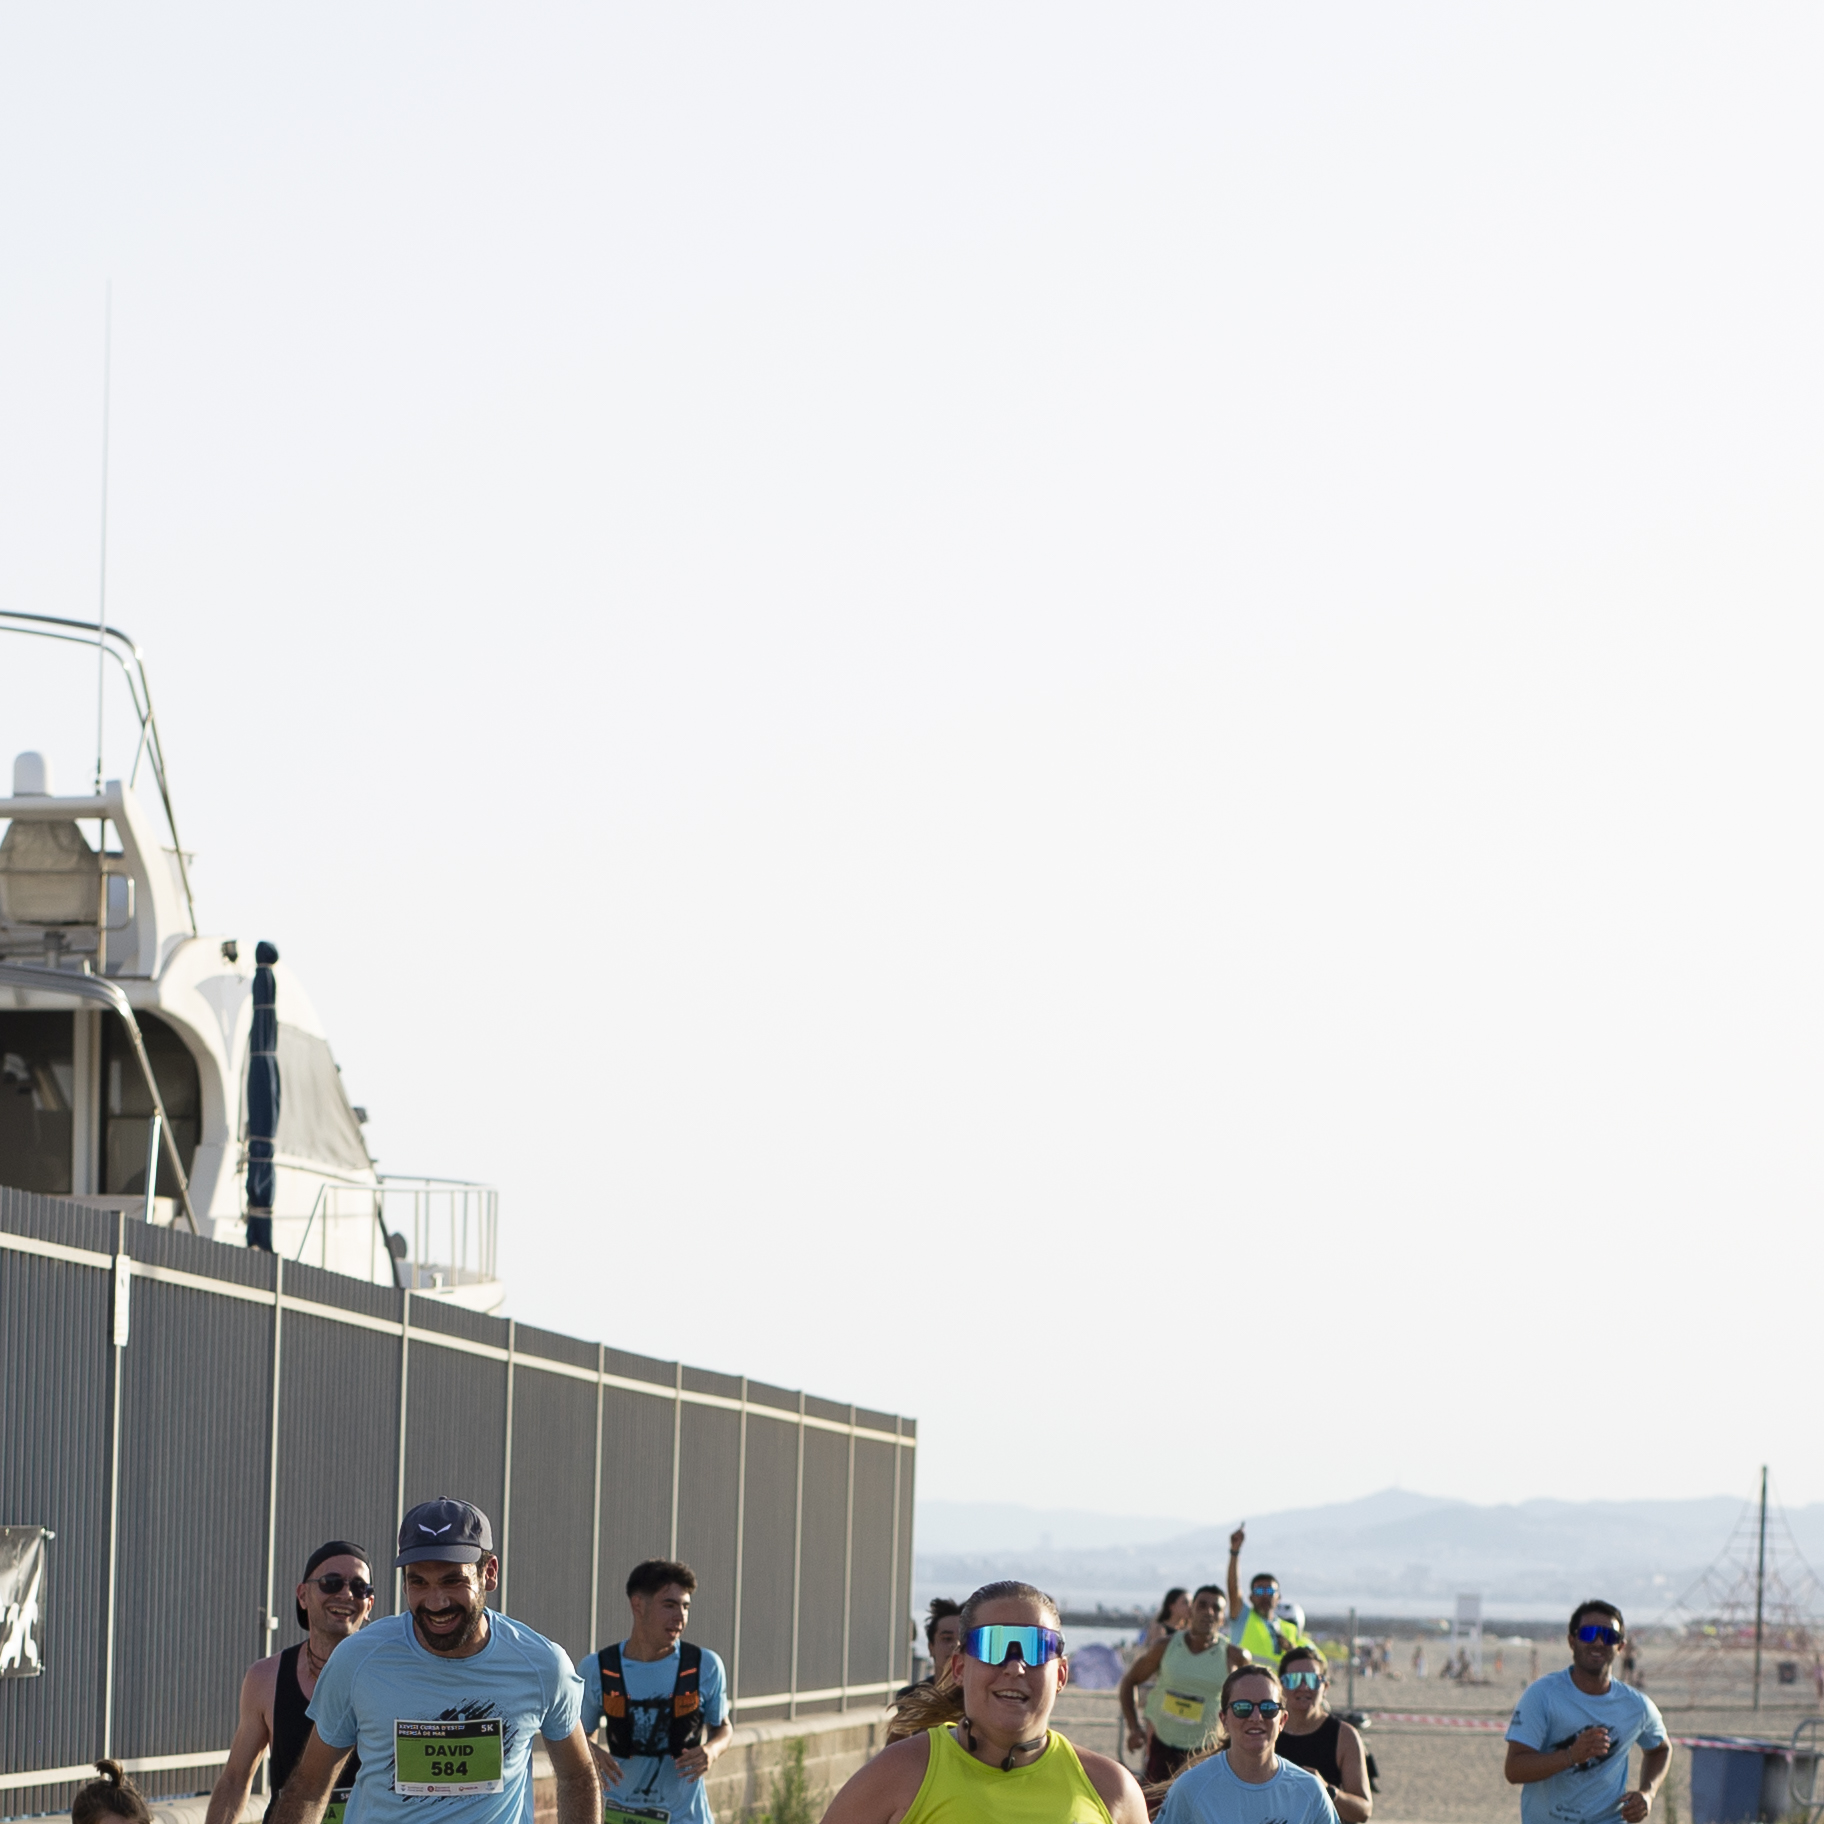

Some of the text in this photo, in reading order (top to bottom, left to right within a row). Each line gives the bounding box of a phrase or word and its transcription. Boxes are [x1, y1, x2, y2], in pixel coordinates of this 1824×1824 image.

[480, 1723, 494, 1732] 5K
[424, 1744, 474, 1757] DAVID
[431, 1761, 468, 1777] 584
